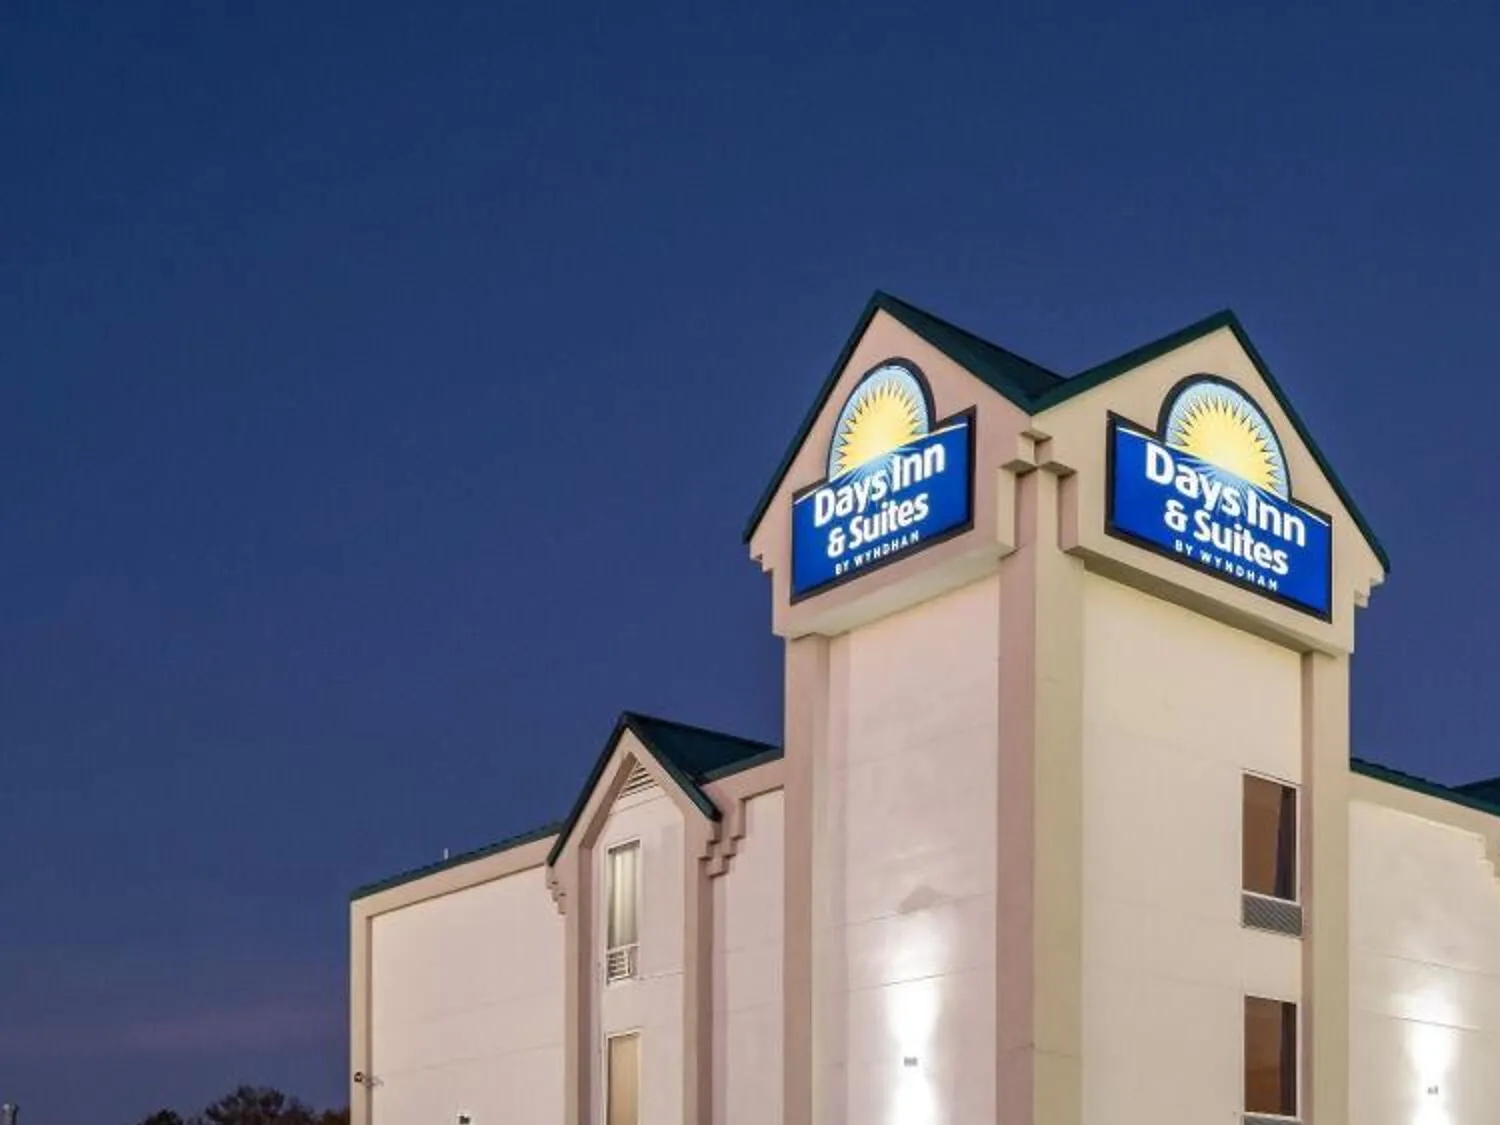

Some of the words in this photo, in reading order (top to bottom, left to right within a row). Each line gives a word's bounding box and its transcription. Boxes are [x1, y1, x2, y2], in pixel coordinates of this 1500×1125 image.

[813, 469, 888, 529] Days
[891, 443, 946, 493] Inn
[1145, 441, 1241, 517] Days
[1246, 488, 1307, 547] Inn
[827, 527, 847, 559] &
[848, 492, 929, 549] Suites
[1163, 498, 1188, 533] &
[1193, 509, 1289, 576] Suites
[835, 559, 850, 575] BY
[1174, 538, 1193, 557] BY
[1200, 548, 1279, 592] WYNDHAM
